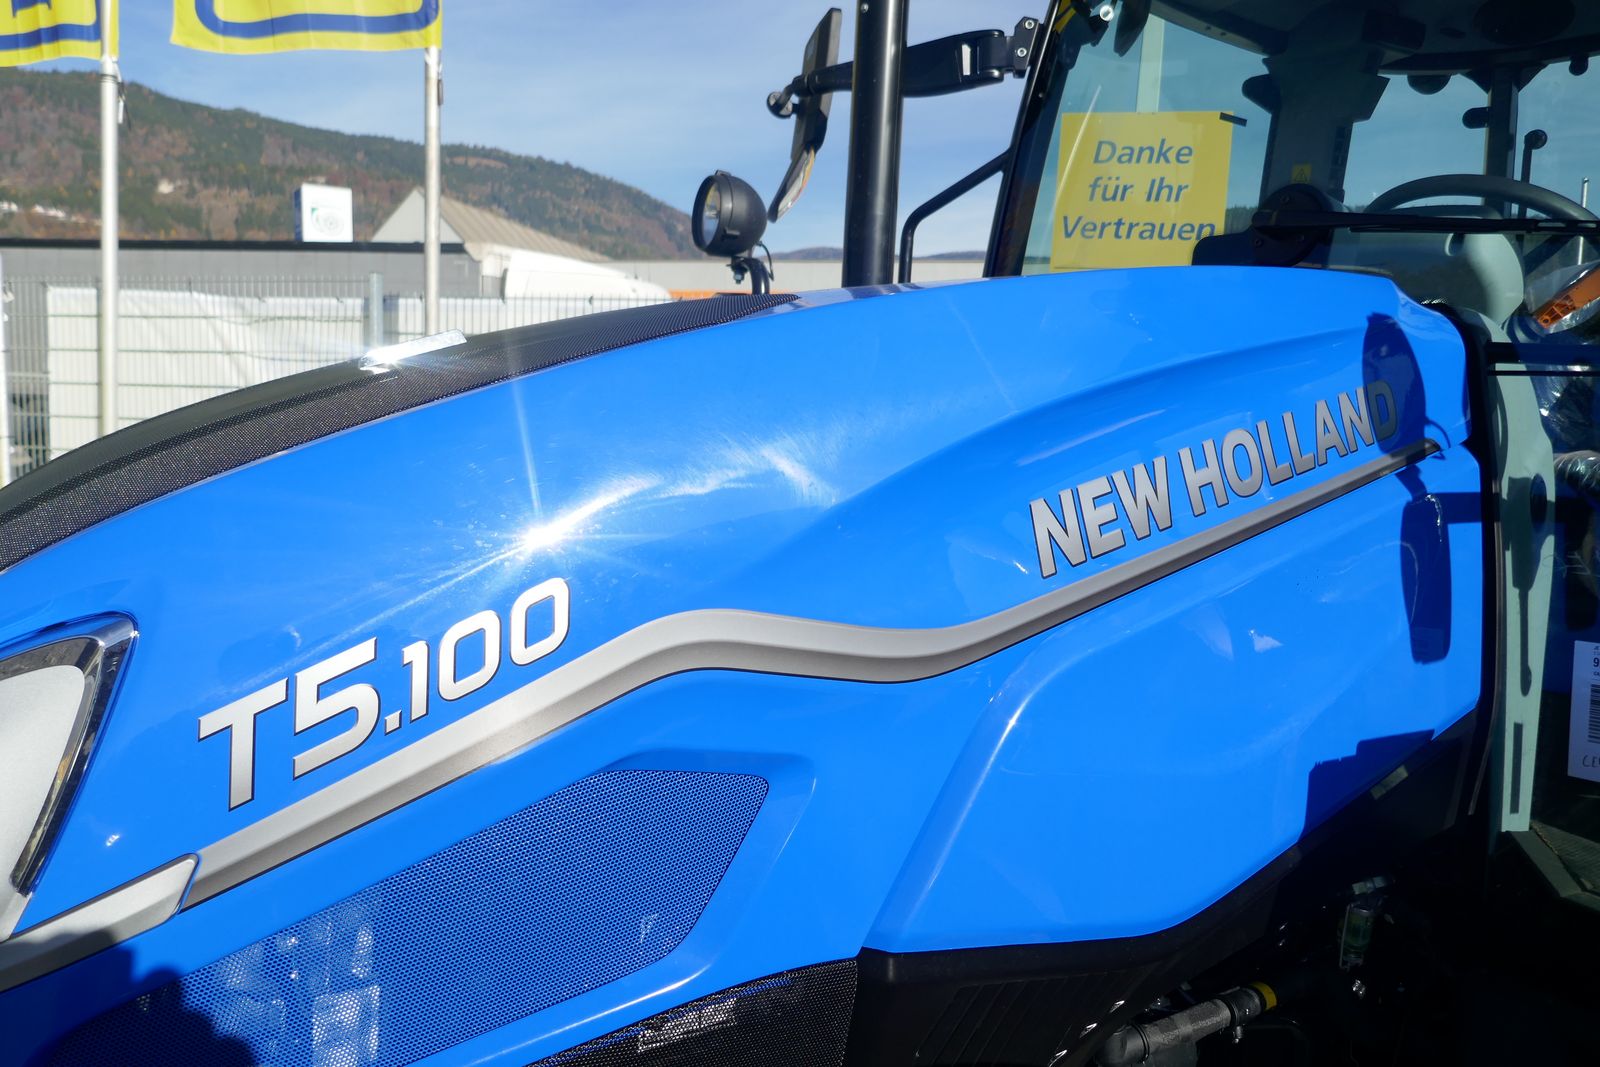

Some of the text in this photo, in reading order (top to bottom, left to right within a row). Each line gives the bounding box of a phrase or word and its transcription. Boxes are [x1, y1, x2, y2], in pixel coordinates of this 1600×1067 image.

[1093, 138, 1193, 165] Danke
[1088, 176, 1189, 202] für Ihr
[1062, 215, 1216, 241] Vertrauen
[1029, 379, 1398, 579] NEW HOLLAND
[198, 577, 571, 811] T5.100
